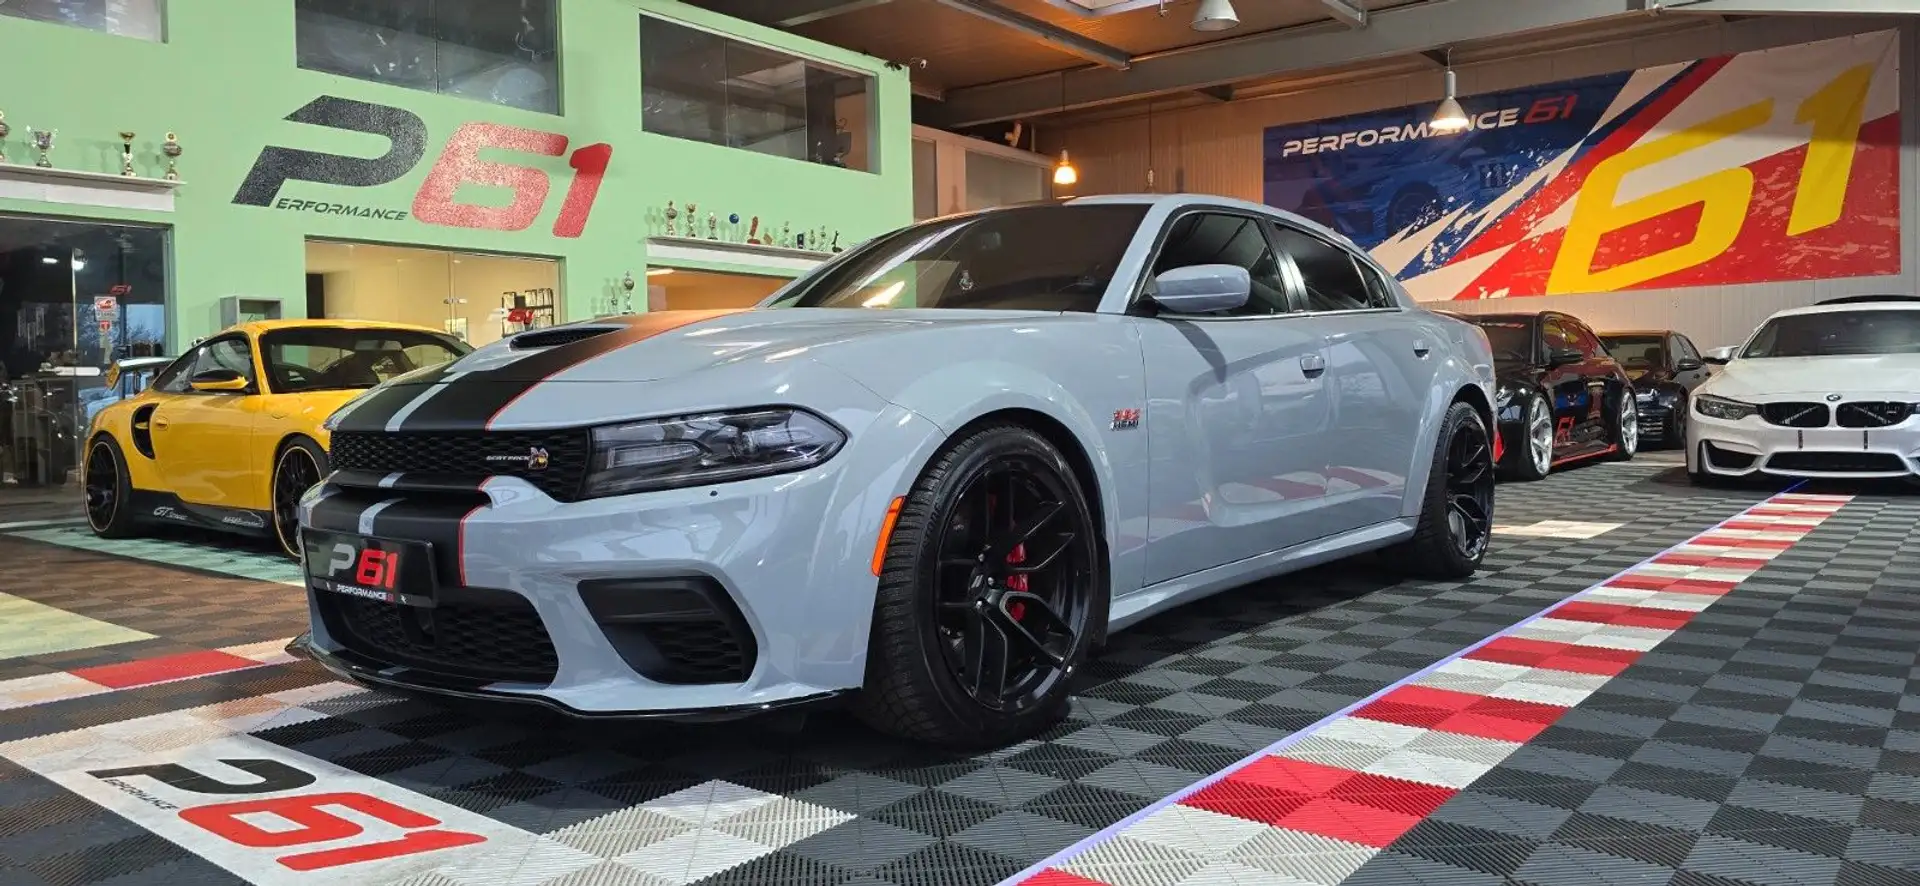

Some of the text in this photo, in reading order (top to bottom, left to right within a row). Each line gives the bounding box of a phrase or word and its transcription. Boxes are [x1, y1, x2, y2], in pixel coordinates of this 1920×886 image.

[1523, 94, 1579, 124] 61
[1545, 61, 1876, 296] 61
[328, 543, 398, 589] P61
[336, 583, 386, 601] PERFORMANCE
